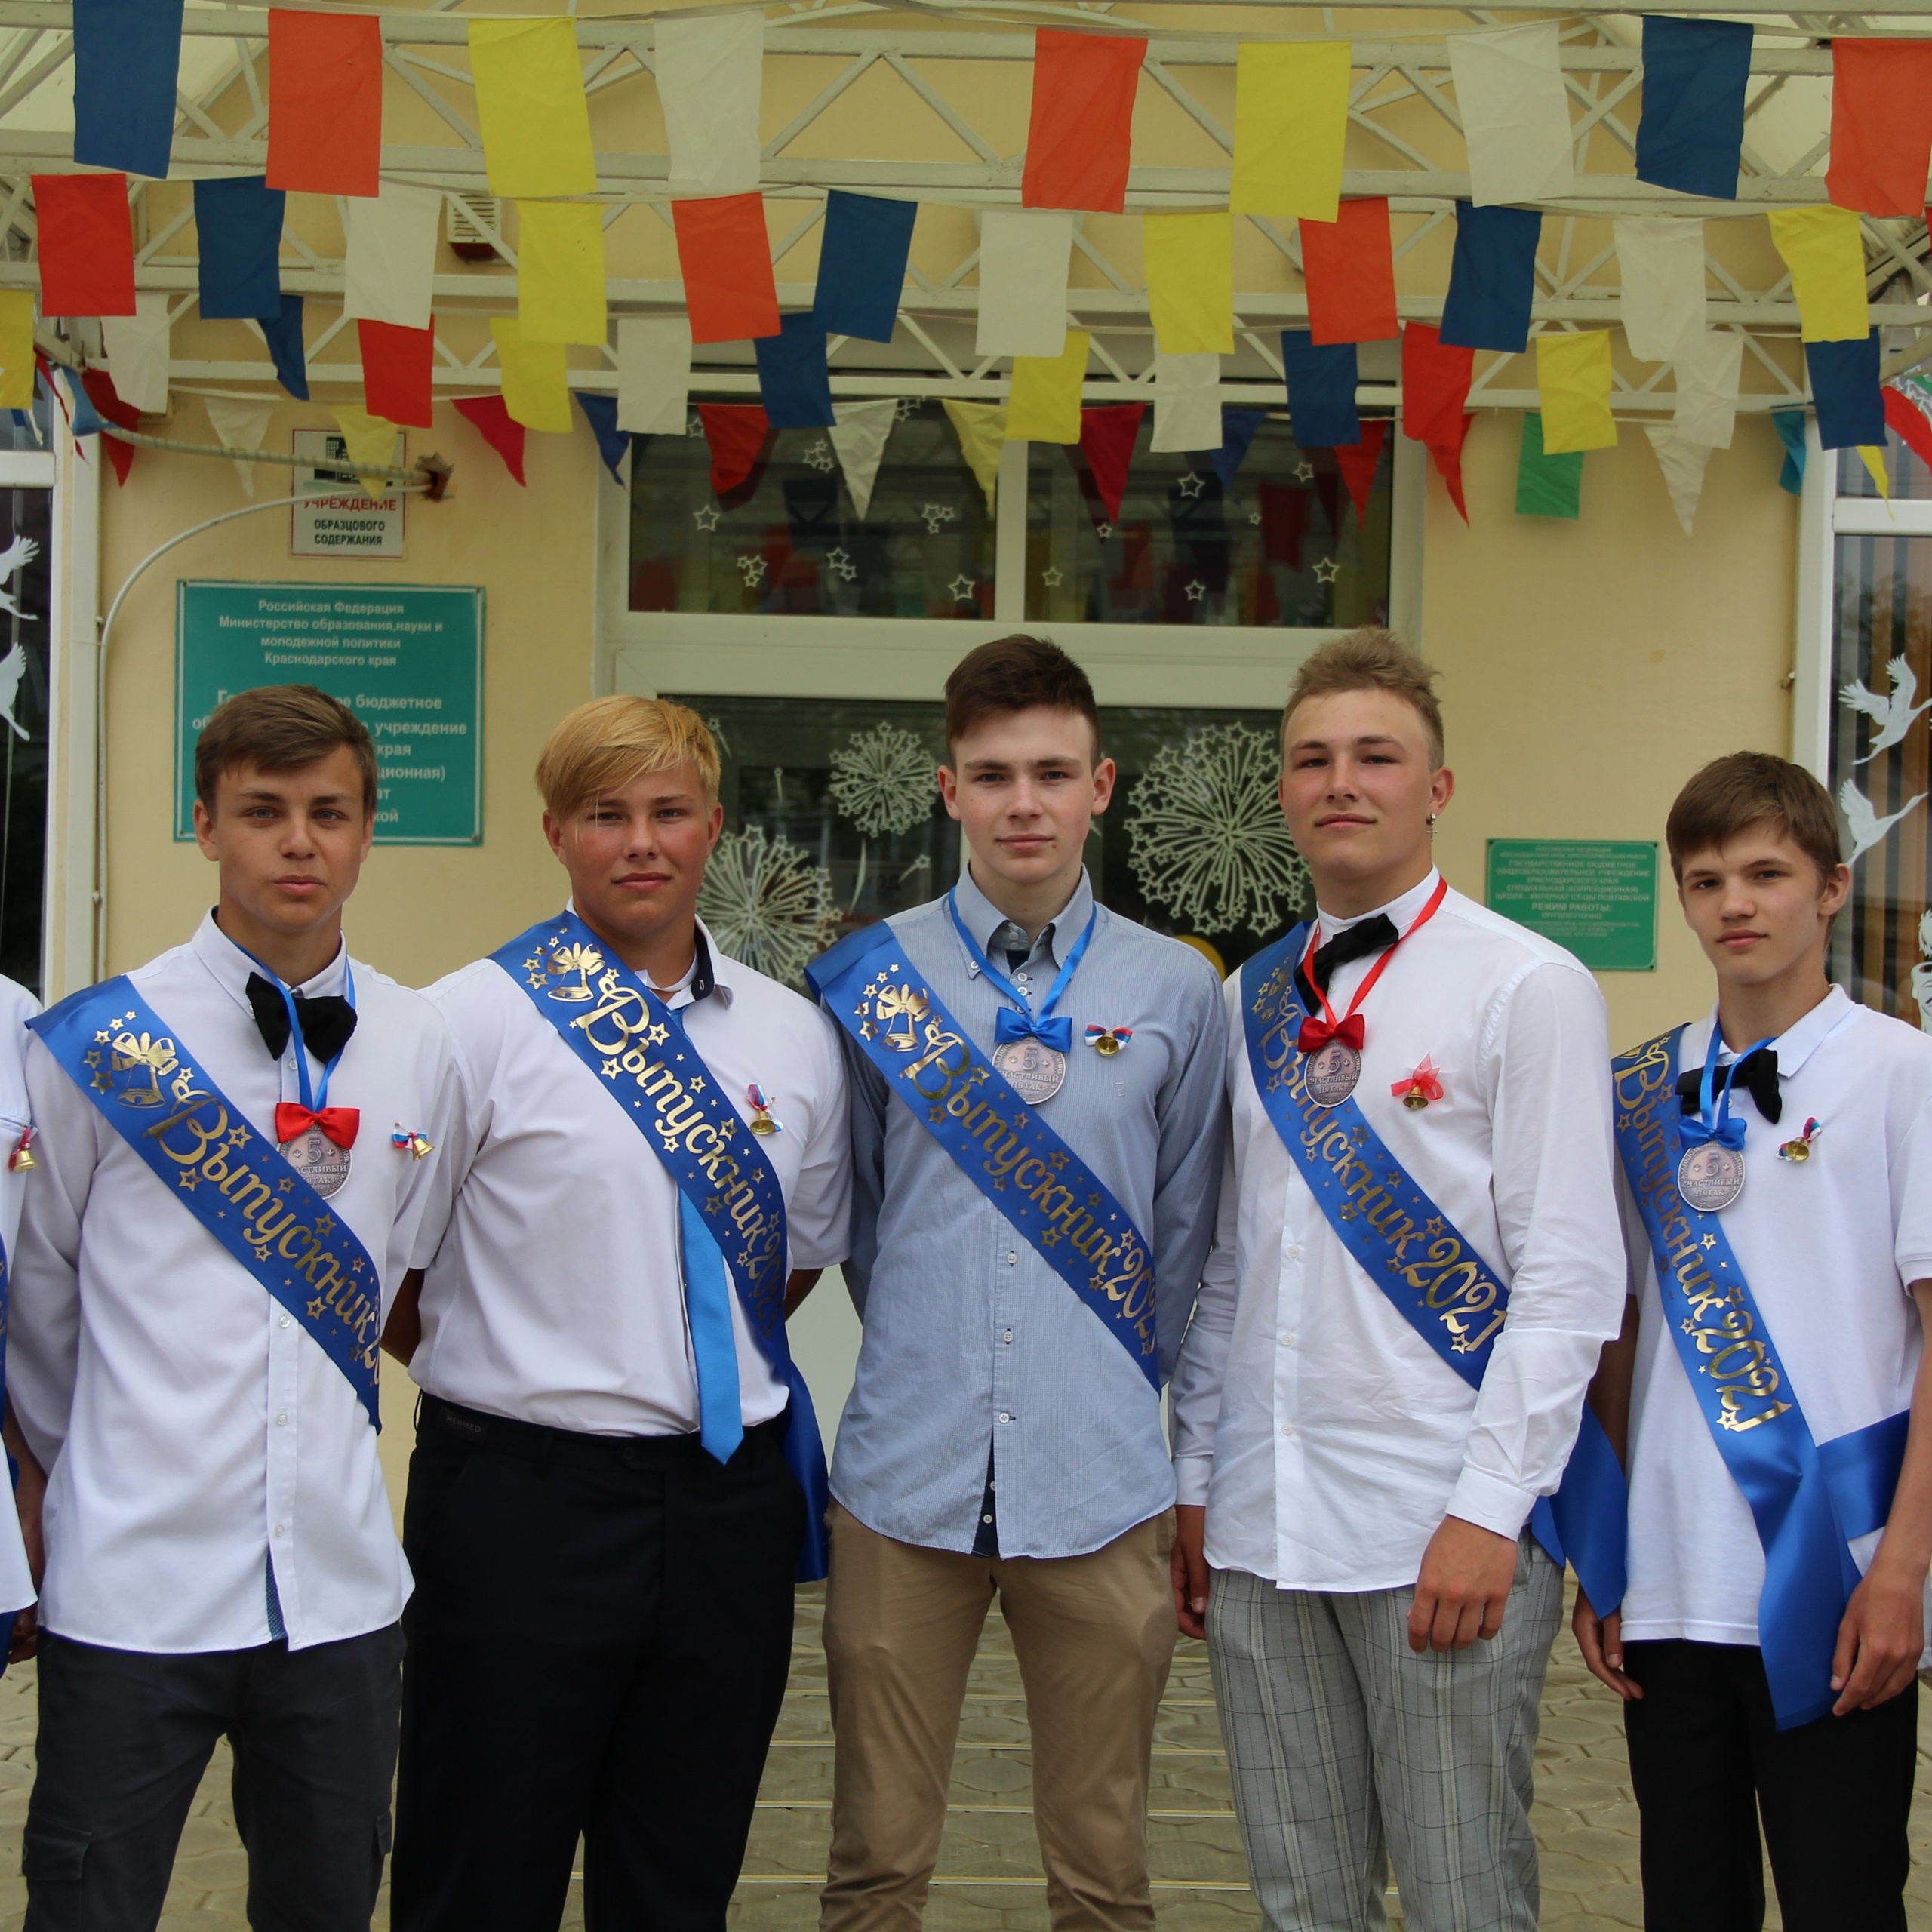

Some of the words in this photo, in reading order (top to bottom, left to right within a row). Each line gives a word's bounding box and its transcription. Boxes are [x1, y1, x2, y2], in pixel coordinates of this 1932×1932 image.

[303, 496, 397, 511] УЧРЕЖДЕНИЕ
[314, 518, 386, 532] ОБРАЗЦОВОГО
[314, 534, 383, 546] СОДЕРЖАНИЯ
[258, 600, 331, 612] Российская
[334, 601, 404, 616] Федерация
[219, 615, 309, 631] Министерство
[435, 623, 443, 632] и
[260, 636, 339, 648] молодежной
[343, 638, 401, 648] политики
[264, 651, 365, 666] Краснодарского
[368, 656, 397, 667] края
[355, 693, 442, 711] бюджетное
[374, 721, 467, 737] учреждение
[377, 743, 411, 758] края
[1531, 902, 1567, 911] РЕЖИМ
[1022, 1049, 1037, 1070] 5
[1328, 1051, 1340, 1073] 5
[1001, 1072, 1059, 1082] ЧАСТЛИВЫЙ
[1308, 1072, 1358, 1084] СЧАСТЛИВЫЙ
[1318, 1085, 1343, 1094] ПЯТАК
[576, 975, 768, 1253] Выпускник
[307, 1140, 321, 1163] 5
[904, 1023, 1122, 1275] Выпускник
[295, 1164, 347, 1174] АСТЛИВЫЙ
[1706, 1155, 1718, 1176] 5
[305, 1176, 331, 1185] ЯТАК
[1681, 1177, 1740, 1188] СЧАСТЛИВЫЙ
[1694, 1189, 1724, 1197] ПЯТАК
[142, 1078, 376, 1344] Выпускник
[1614, 1042, 1724, 1322] Выпускник
[1691, 1310, 1792, 1432] 2021
[1399, 1237, 1508, 1352] 2021
